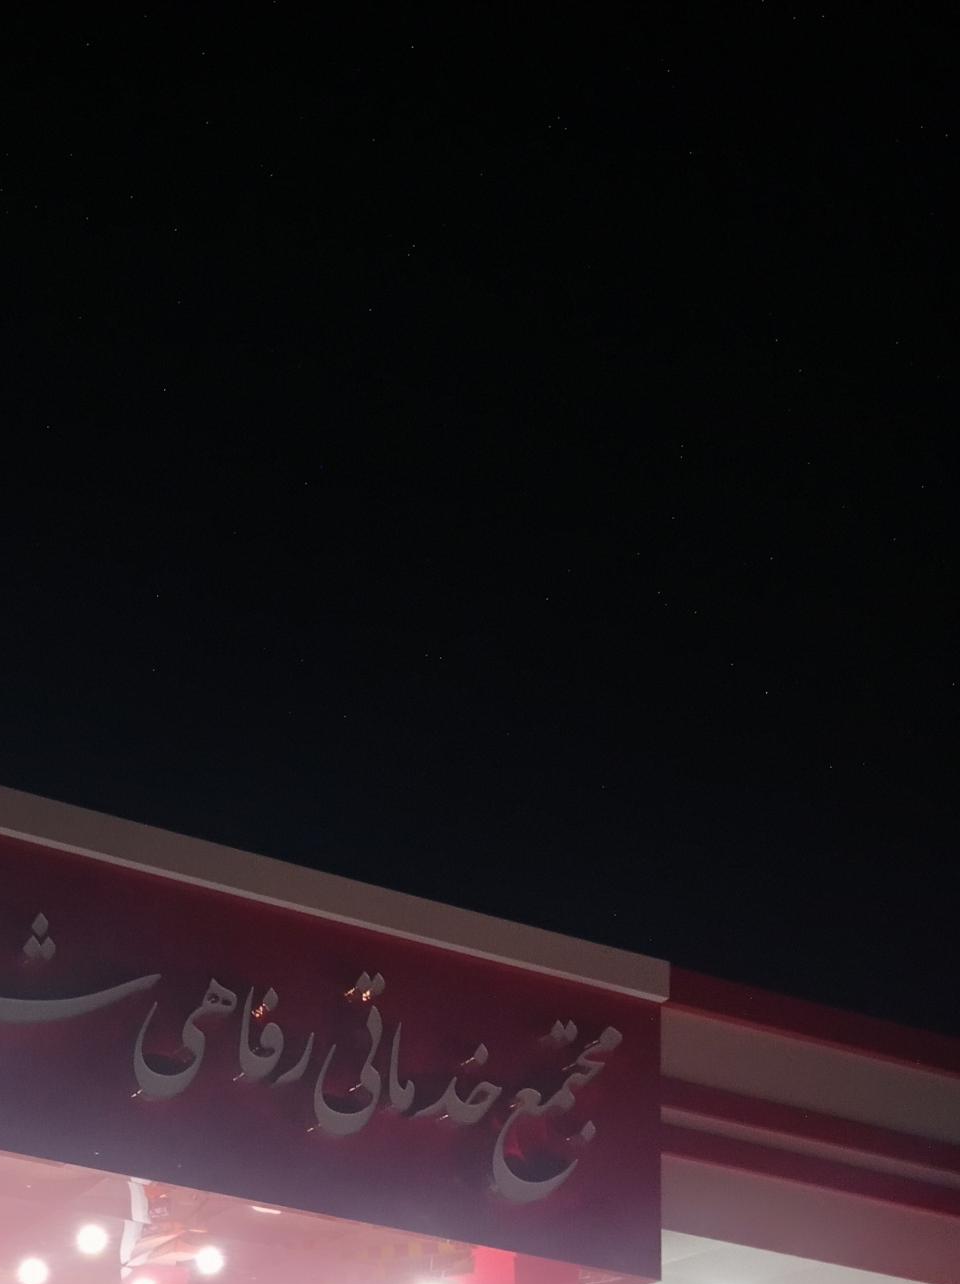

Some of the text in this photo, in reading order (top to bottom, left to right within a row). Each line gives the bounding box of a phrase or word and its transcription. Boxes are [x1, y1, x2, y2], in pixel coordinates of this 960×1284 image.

[132, 976, 316, 1100] رفاهی
[313, 970, 502, 1136] خدماتی
[491, 1019, 625, 1201] مجتمع
